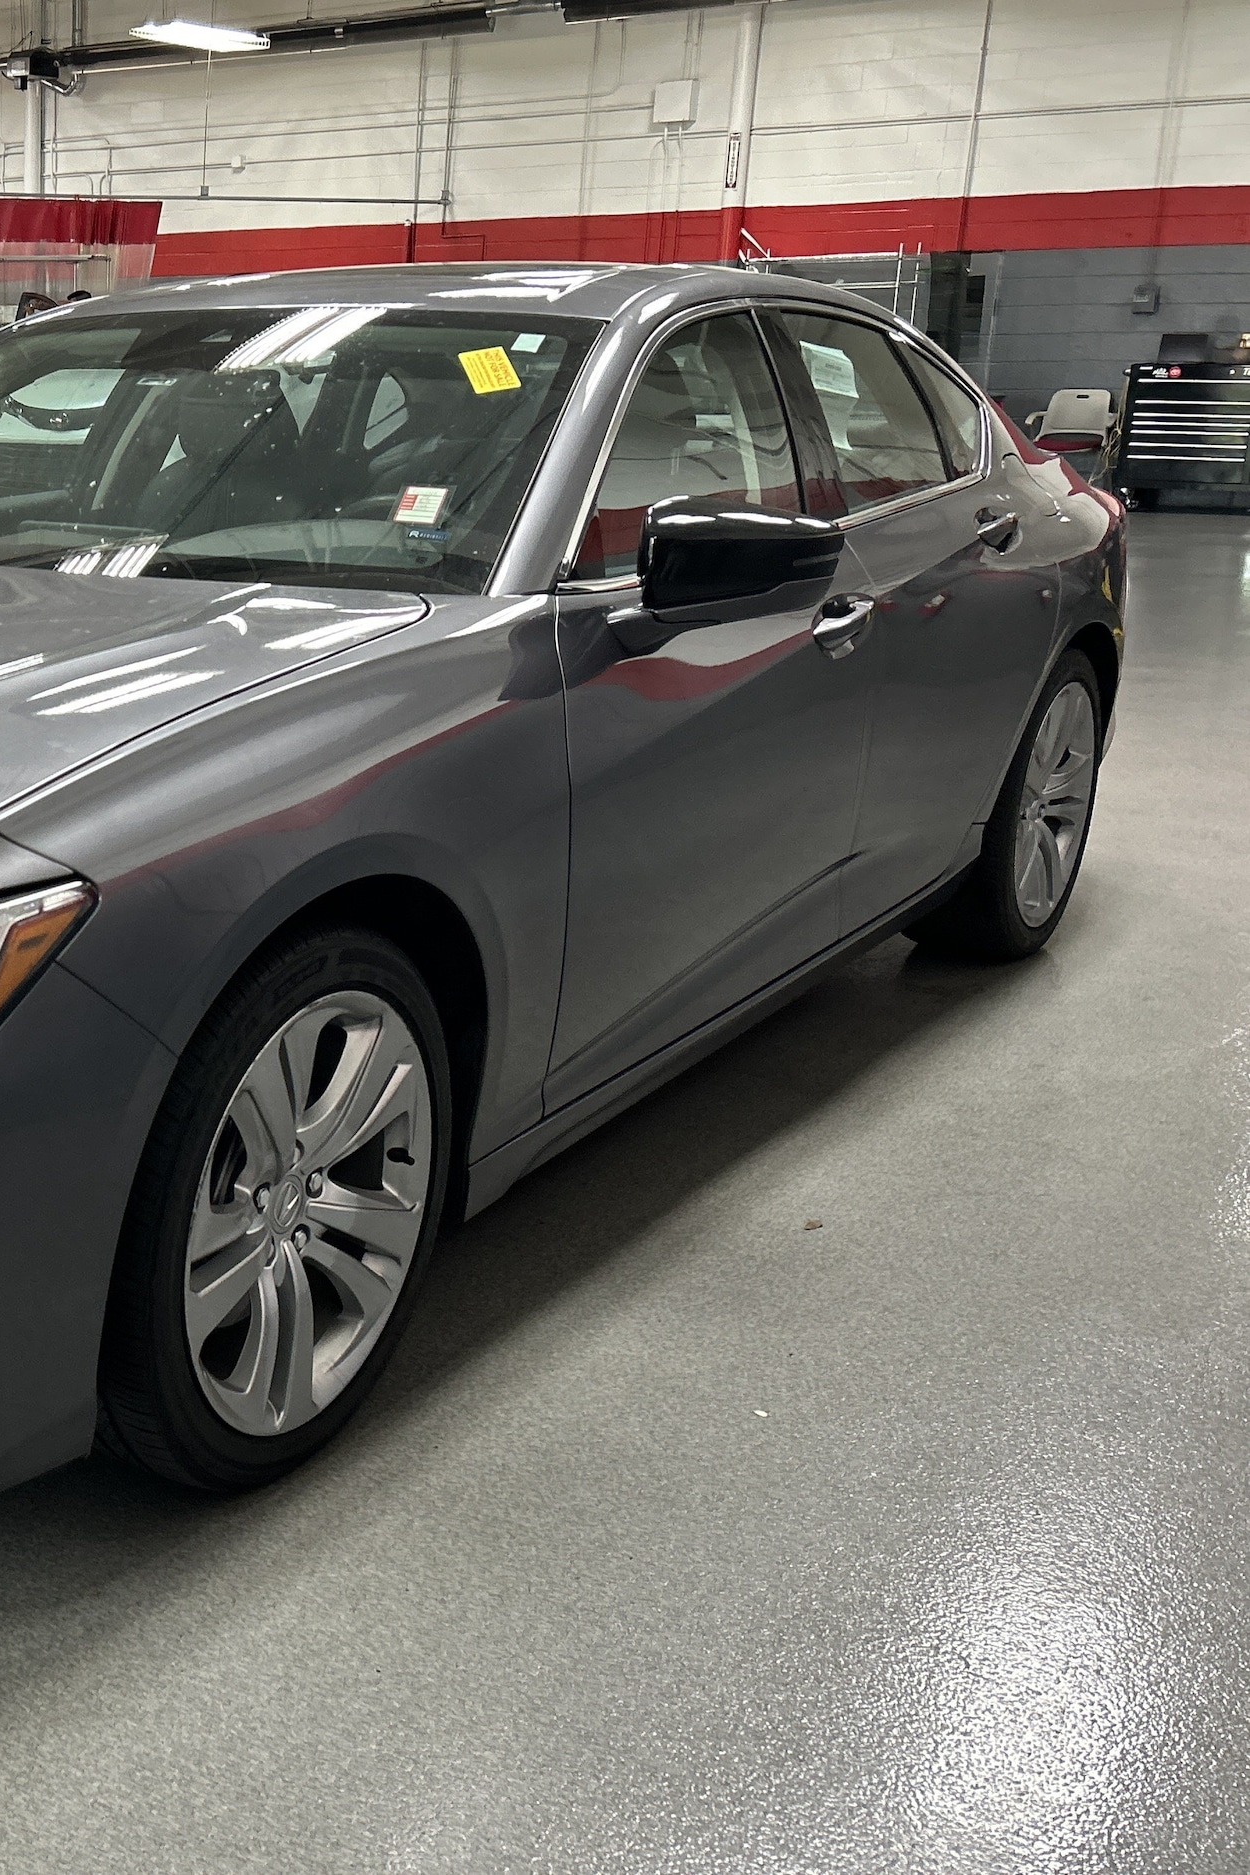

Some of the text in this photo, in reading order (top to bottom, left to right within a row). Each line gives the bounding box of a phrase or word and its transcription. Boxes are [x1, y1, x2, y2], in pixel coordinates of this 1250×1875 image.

[484, 351, 506, 387] NOT FOR SALE
[493, 349, 516, 386] THIS VEHICLE
